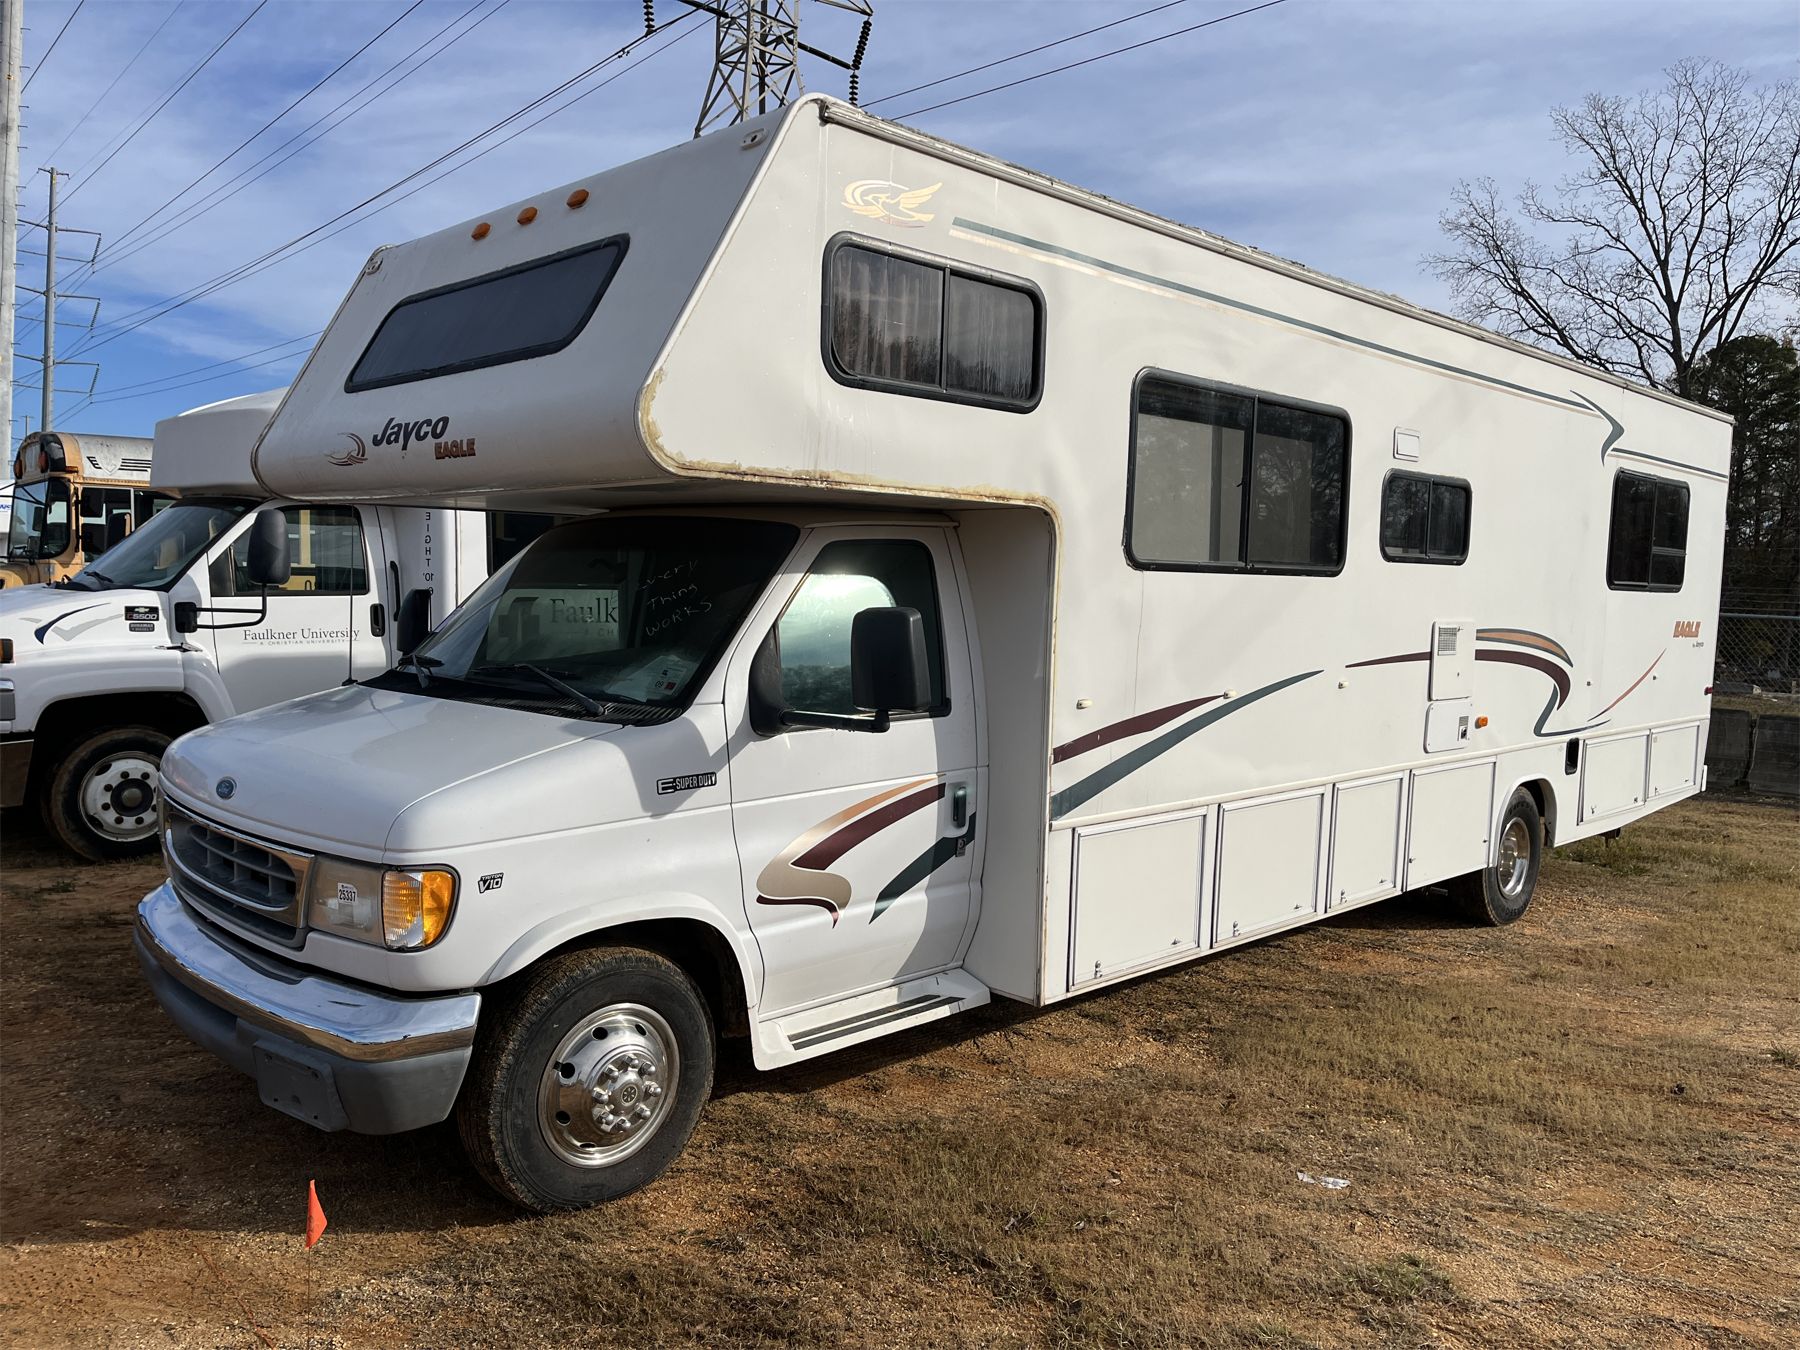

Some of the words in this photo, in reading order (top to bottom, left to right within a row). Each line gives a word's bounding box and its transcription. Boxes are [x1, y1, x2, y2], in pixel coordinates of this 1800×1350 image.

[372, 416, 449, 451] Jayco
[434, 438, 476, 460] EAGLE
[243, 629, 298, 640] Faulkner
[301, 627, 360, 641] Universiy
[1673, 621, 1701, 638] EAGLE
[699, 773, 716, 786] DUTY
[479, 878, 502, 893] V10
[339, 889, 356, 902] 25337
